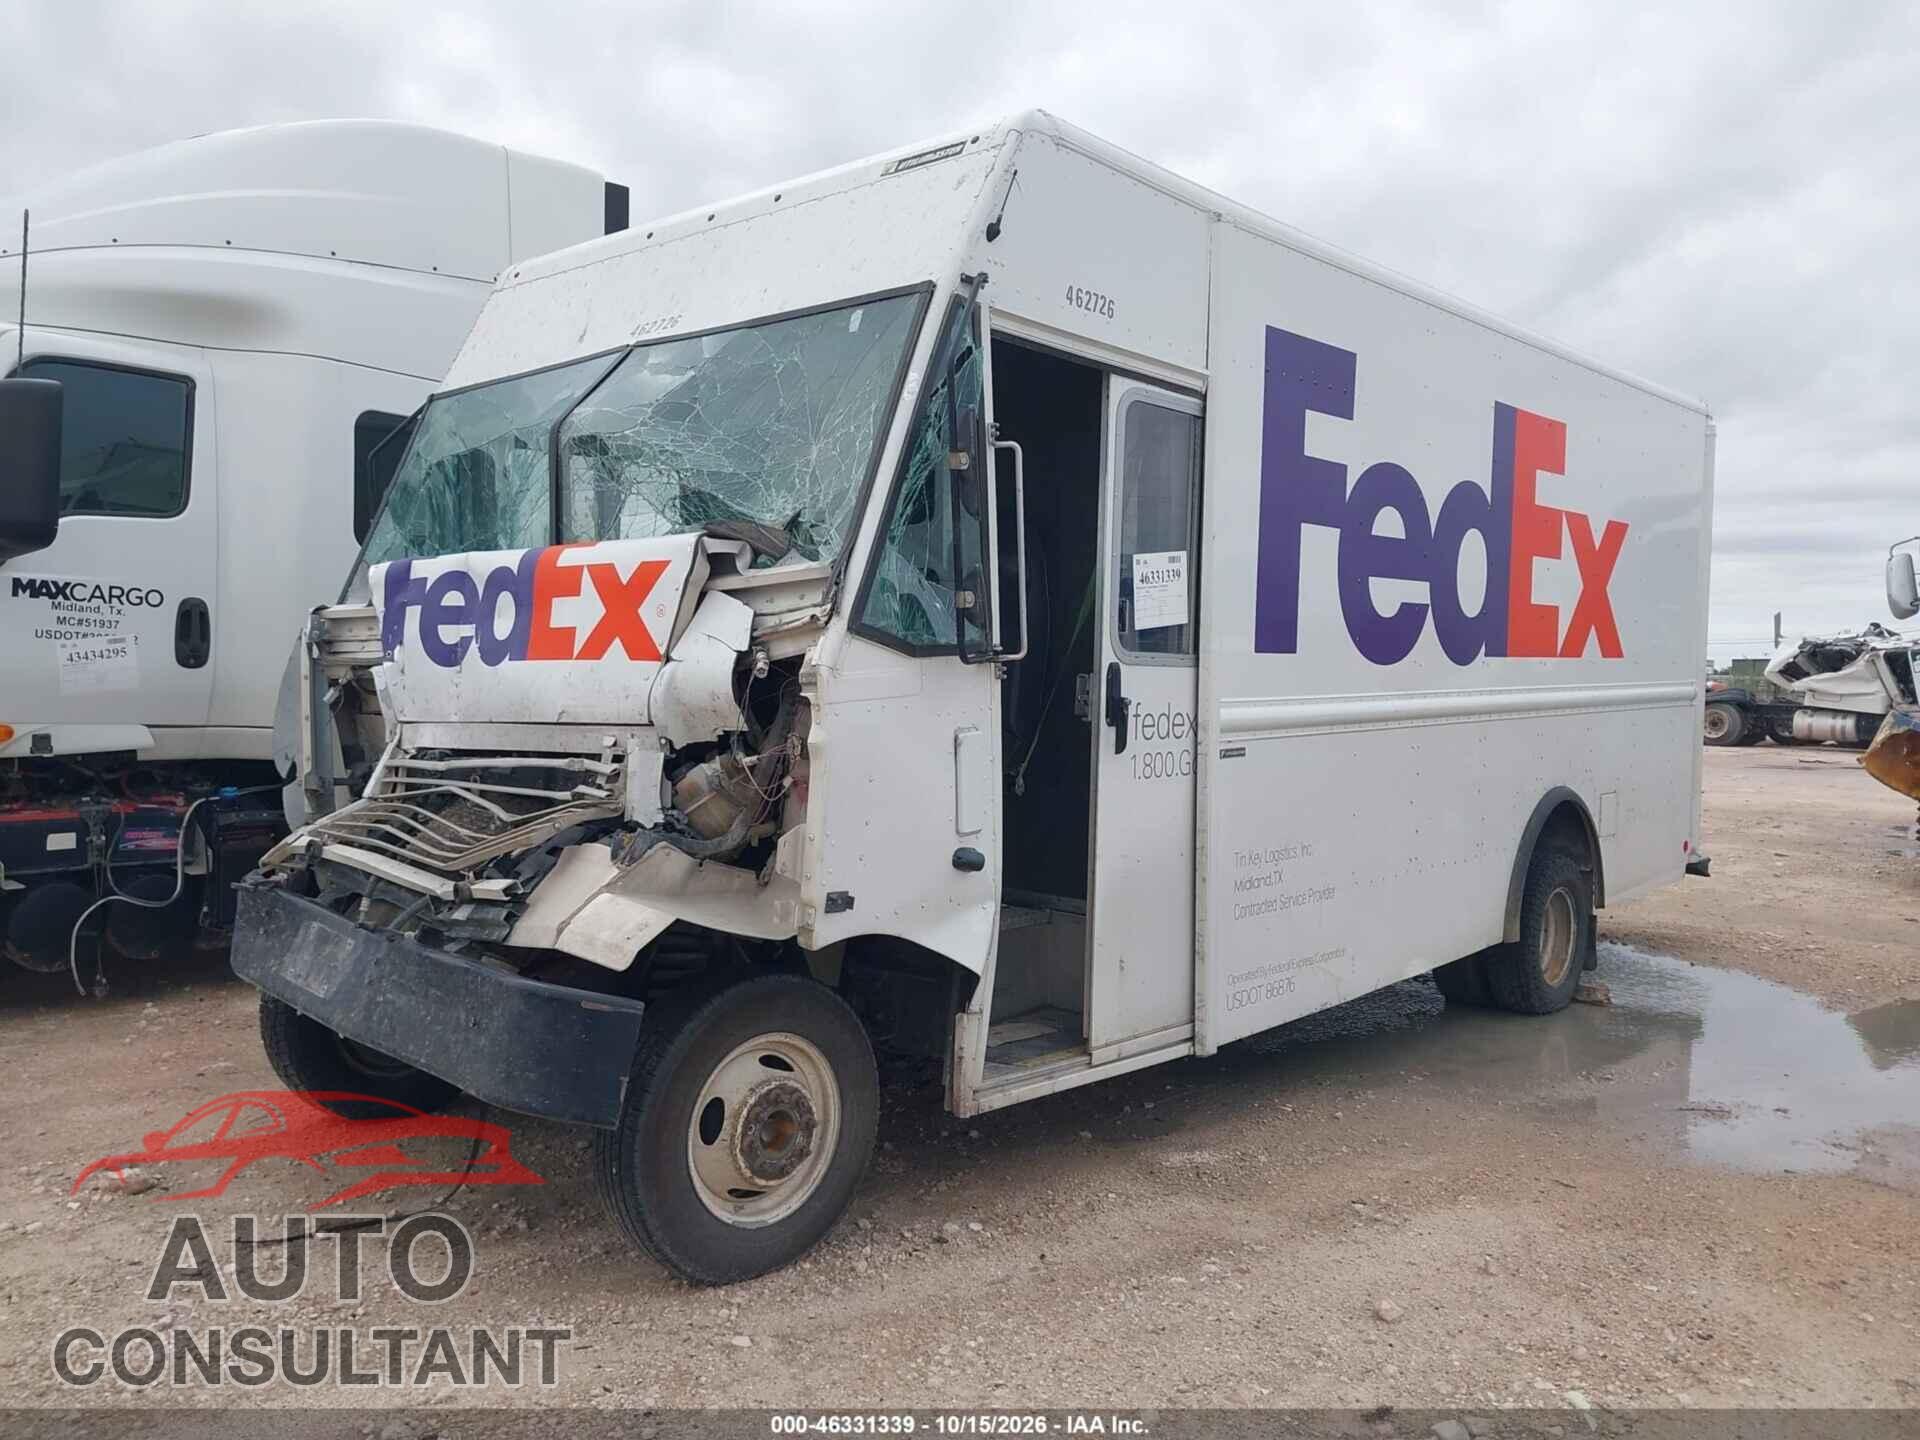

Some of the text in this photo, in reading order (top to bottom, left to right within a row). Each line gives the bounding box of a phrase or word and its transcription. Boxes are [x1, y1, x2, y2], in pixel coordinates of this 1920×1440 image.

[1066, 285, 1116, 319] 462726
[629, 313, 683, 337] 462726
[1254, 324, 1629, 666] FedEx
[12, 577, 164, 608] MAXCARGO
[382, 540, 672, 667] FedEx
[51, 601, 126, 617] Midland, Tx.
[56, 616, 120, 630] MC#51937
[66, 647, 127, 664] 43434295
[1225, 985, 1263, 1011] USDOT
